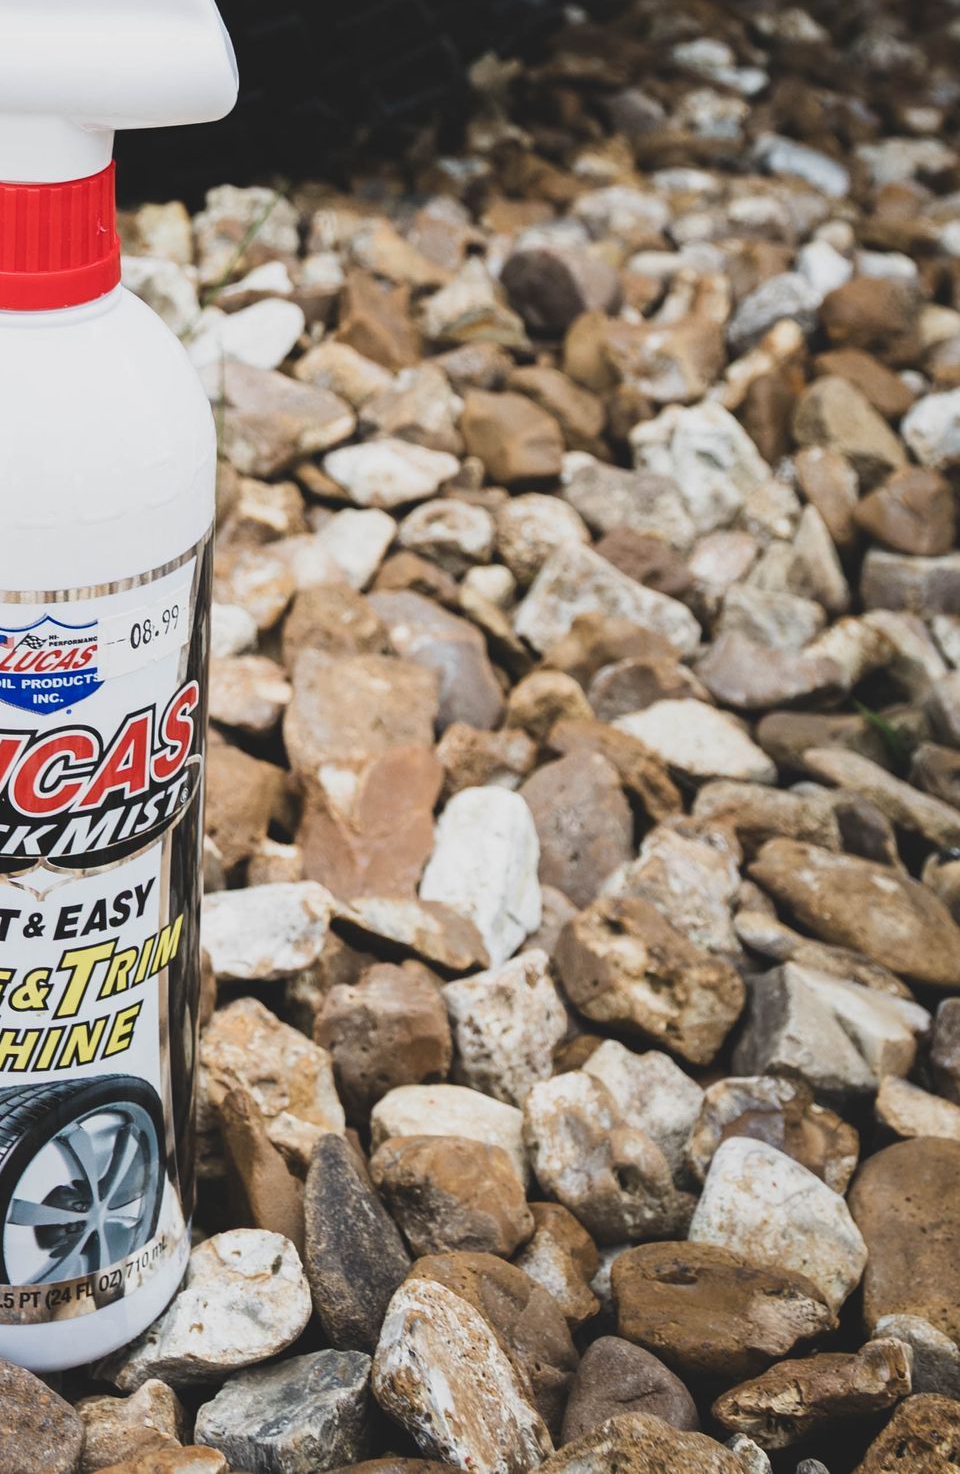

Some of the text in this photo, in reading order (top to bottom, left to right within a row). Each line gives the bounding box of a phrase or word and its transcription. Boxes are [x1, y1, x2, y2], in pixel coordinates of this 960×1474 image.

[48, 635, 98, 647] PERFORMANC
[130, 604, 179, 649] 08.99
[33, 693, 64, 704] INC.
[53, 877, 156, 940] EASY
[20, 1292, 41, 1309] PT
[45, 1287, 72, 1311] (24
[76, 1281, 95, 1300] FL
[99, 1268, 123, 1292] OZ)
[125, 1252, 149, 1278] 710
